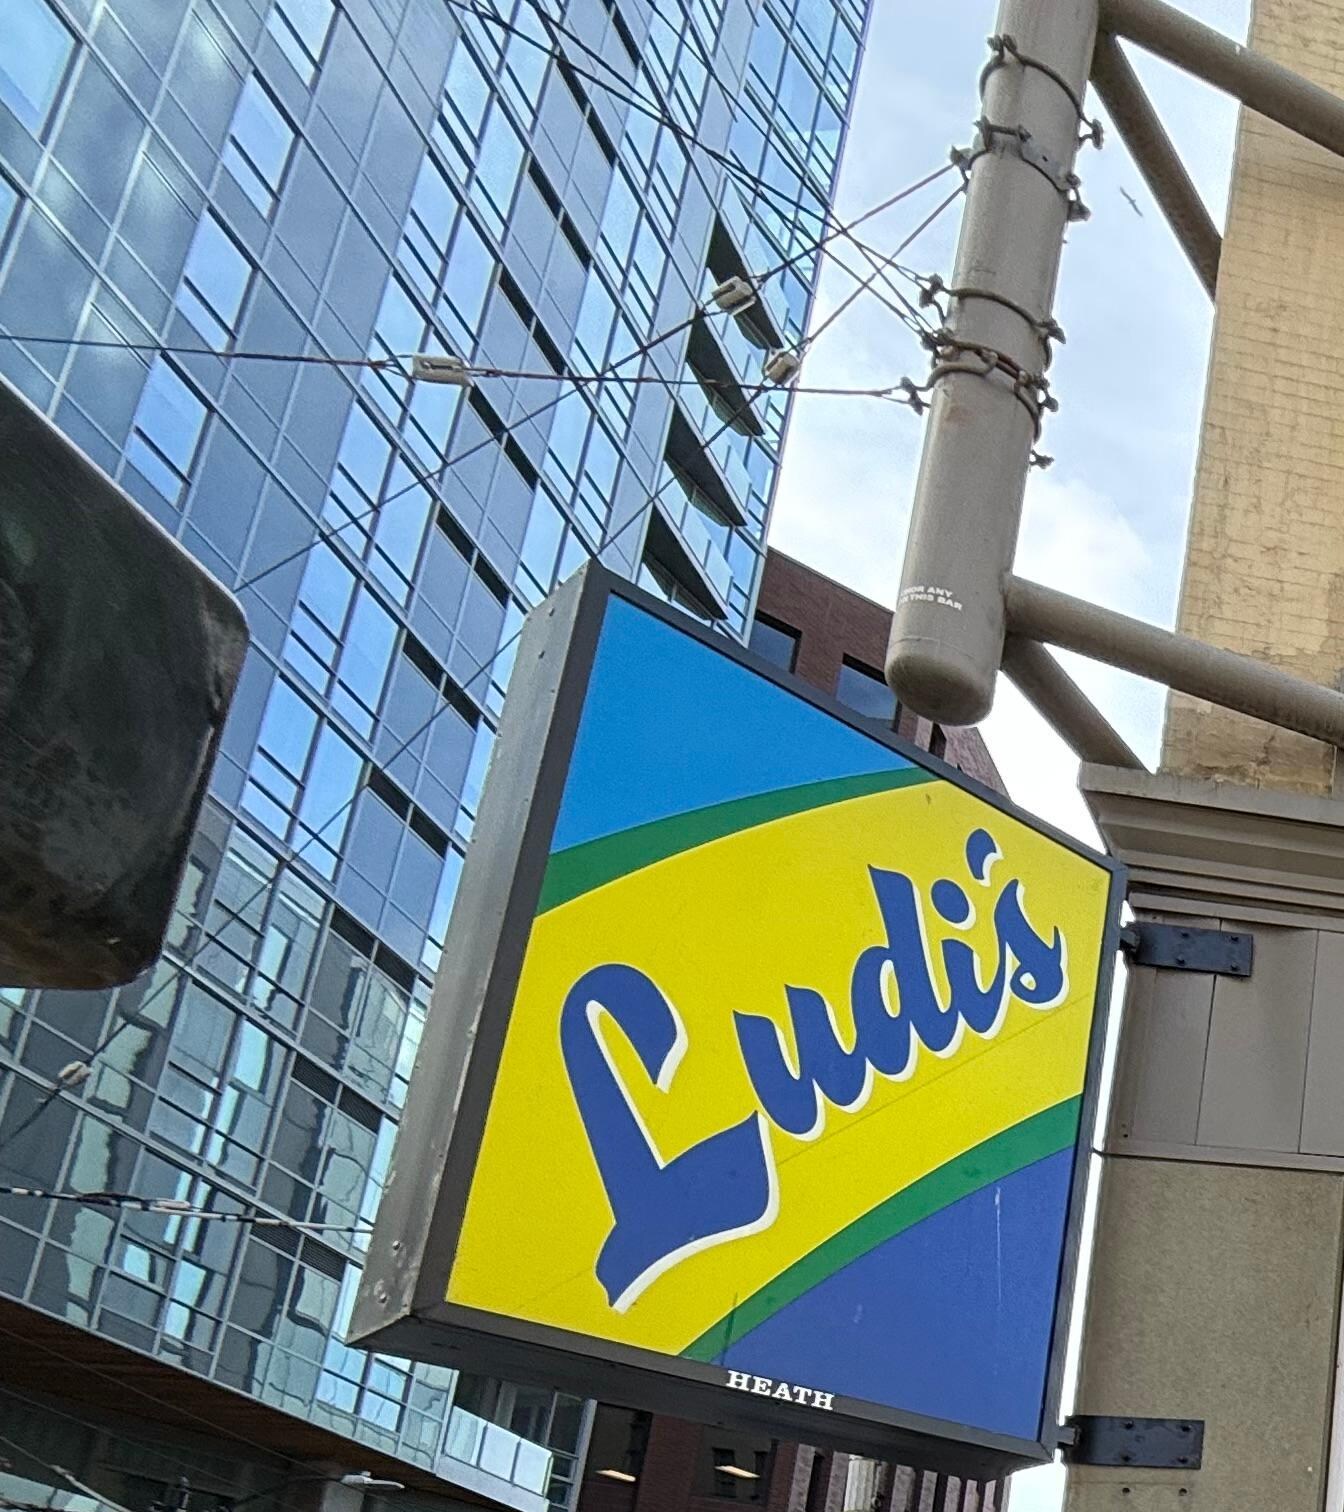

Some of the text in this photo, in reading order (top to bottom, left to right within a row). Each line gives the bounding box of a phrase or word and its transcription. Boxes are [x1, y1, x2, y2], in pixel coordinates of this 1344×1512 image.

[927, 587, 953, 598] ANY
[937, 596, 963, 611] BAR
[559, 828, 1068, 1314] Ludi's
[725, 1370, 835, 1411] HEATH
